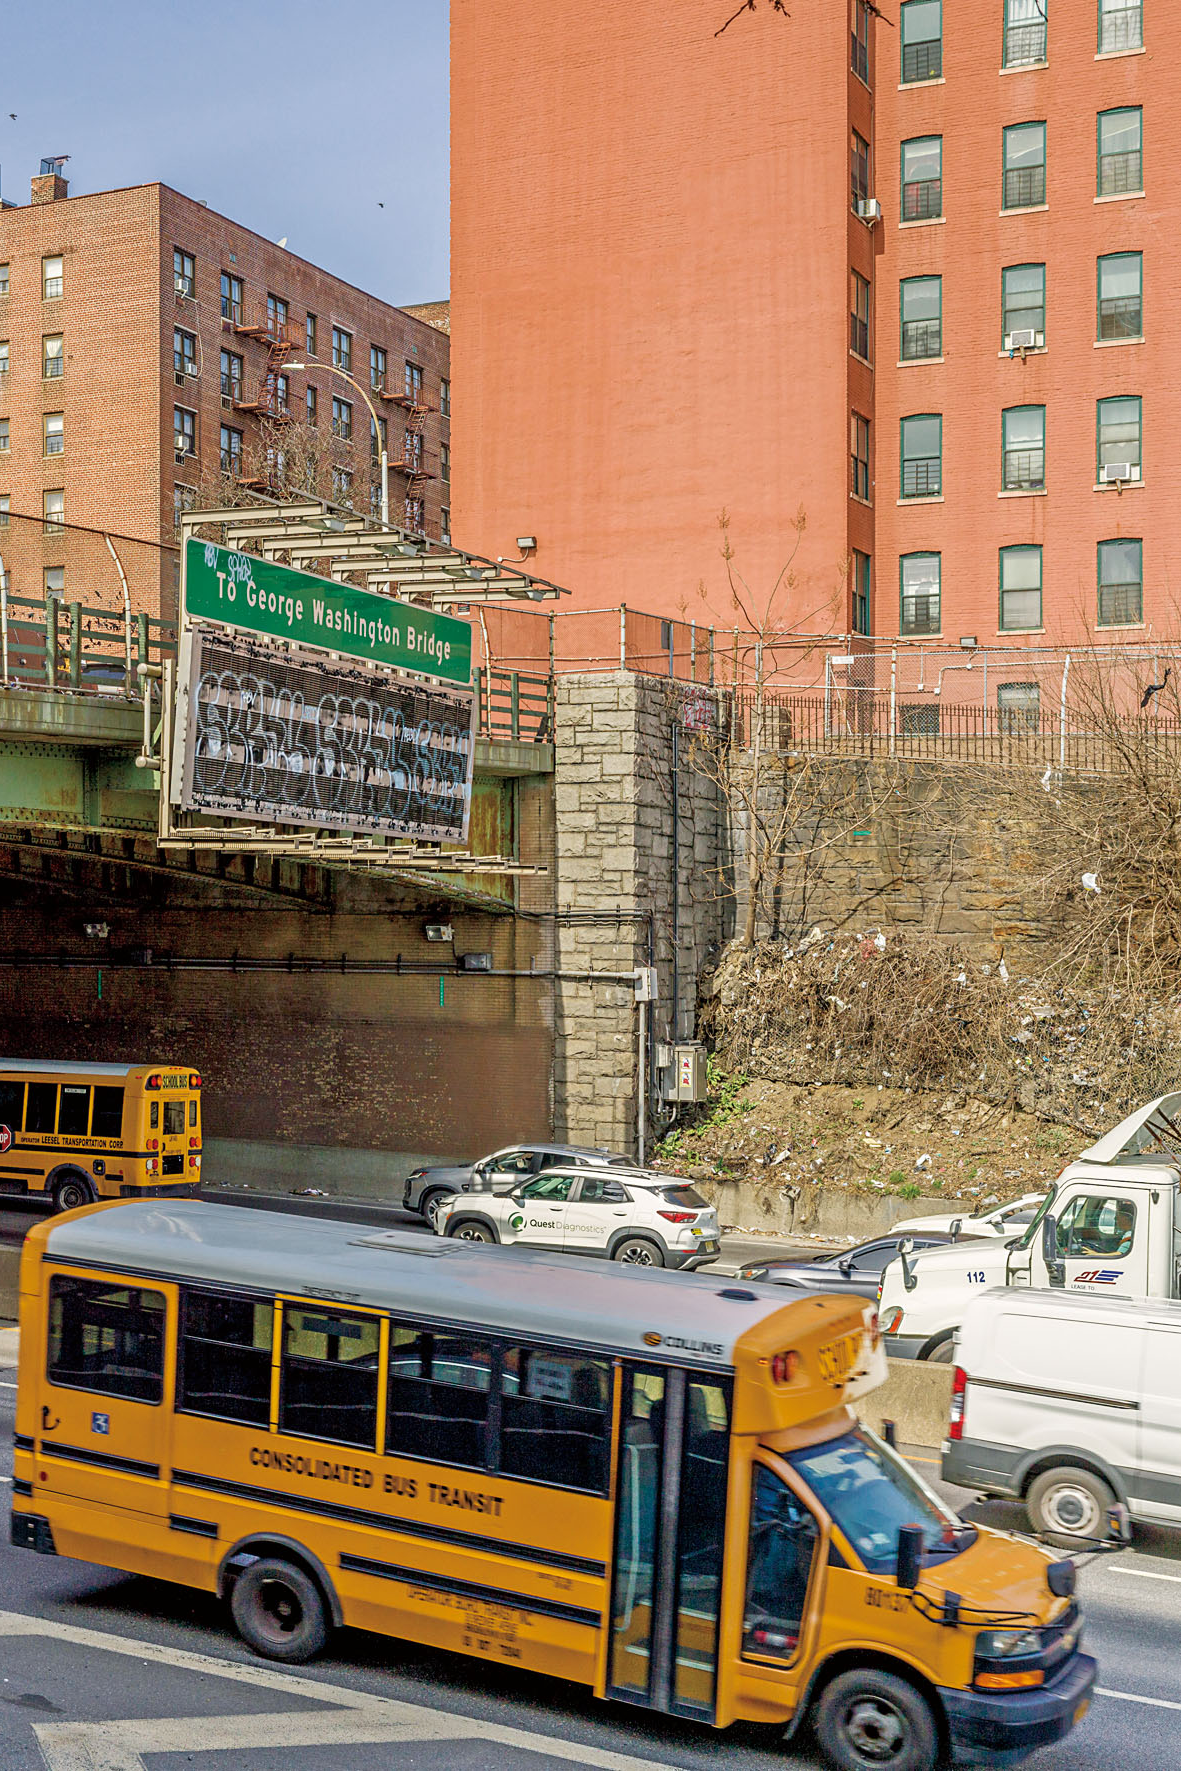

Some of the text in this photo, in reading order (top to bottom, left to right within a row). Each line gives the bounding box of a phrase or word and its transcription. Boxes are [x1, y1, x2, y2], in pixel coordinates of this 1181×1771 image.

[216, 571, 451, 666] To George Washington Bridge
[162, 1074, 188, 1089] SCHOOL BUS
[41, 1135, 60, 1145] LEESEL
[62, 1137, 107, 1149] TRANSPORTATION
[530, 1218, 604, 1234] Quest Diagnostics
[966, 1271, 986, 1284] 112
[663, 1335, 725, 1355] COLLINS
[249, 1447, 506, 1517] CONSOLIDATED BUS TRANSIT
